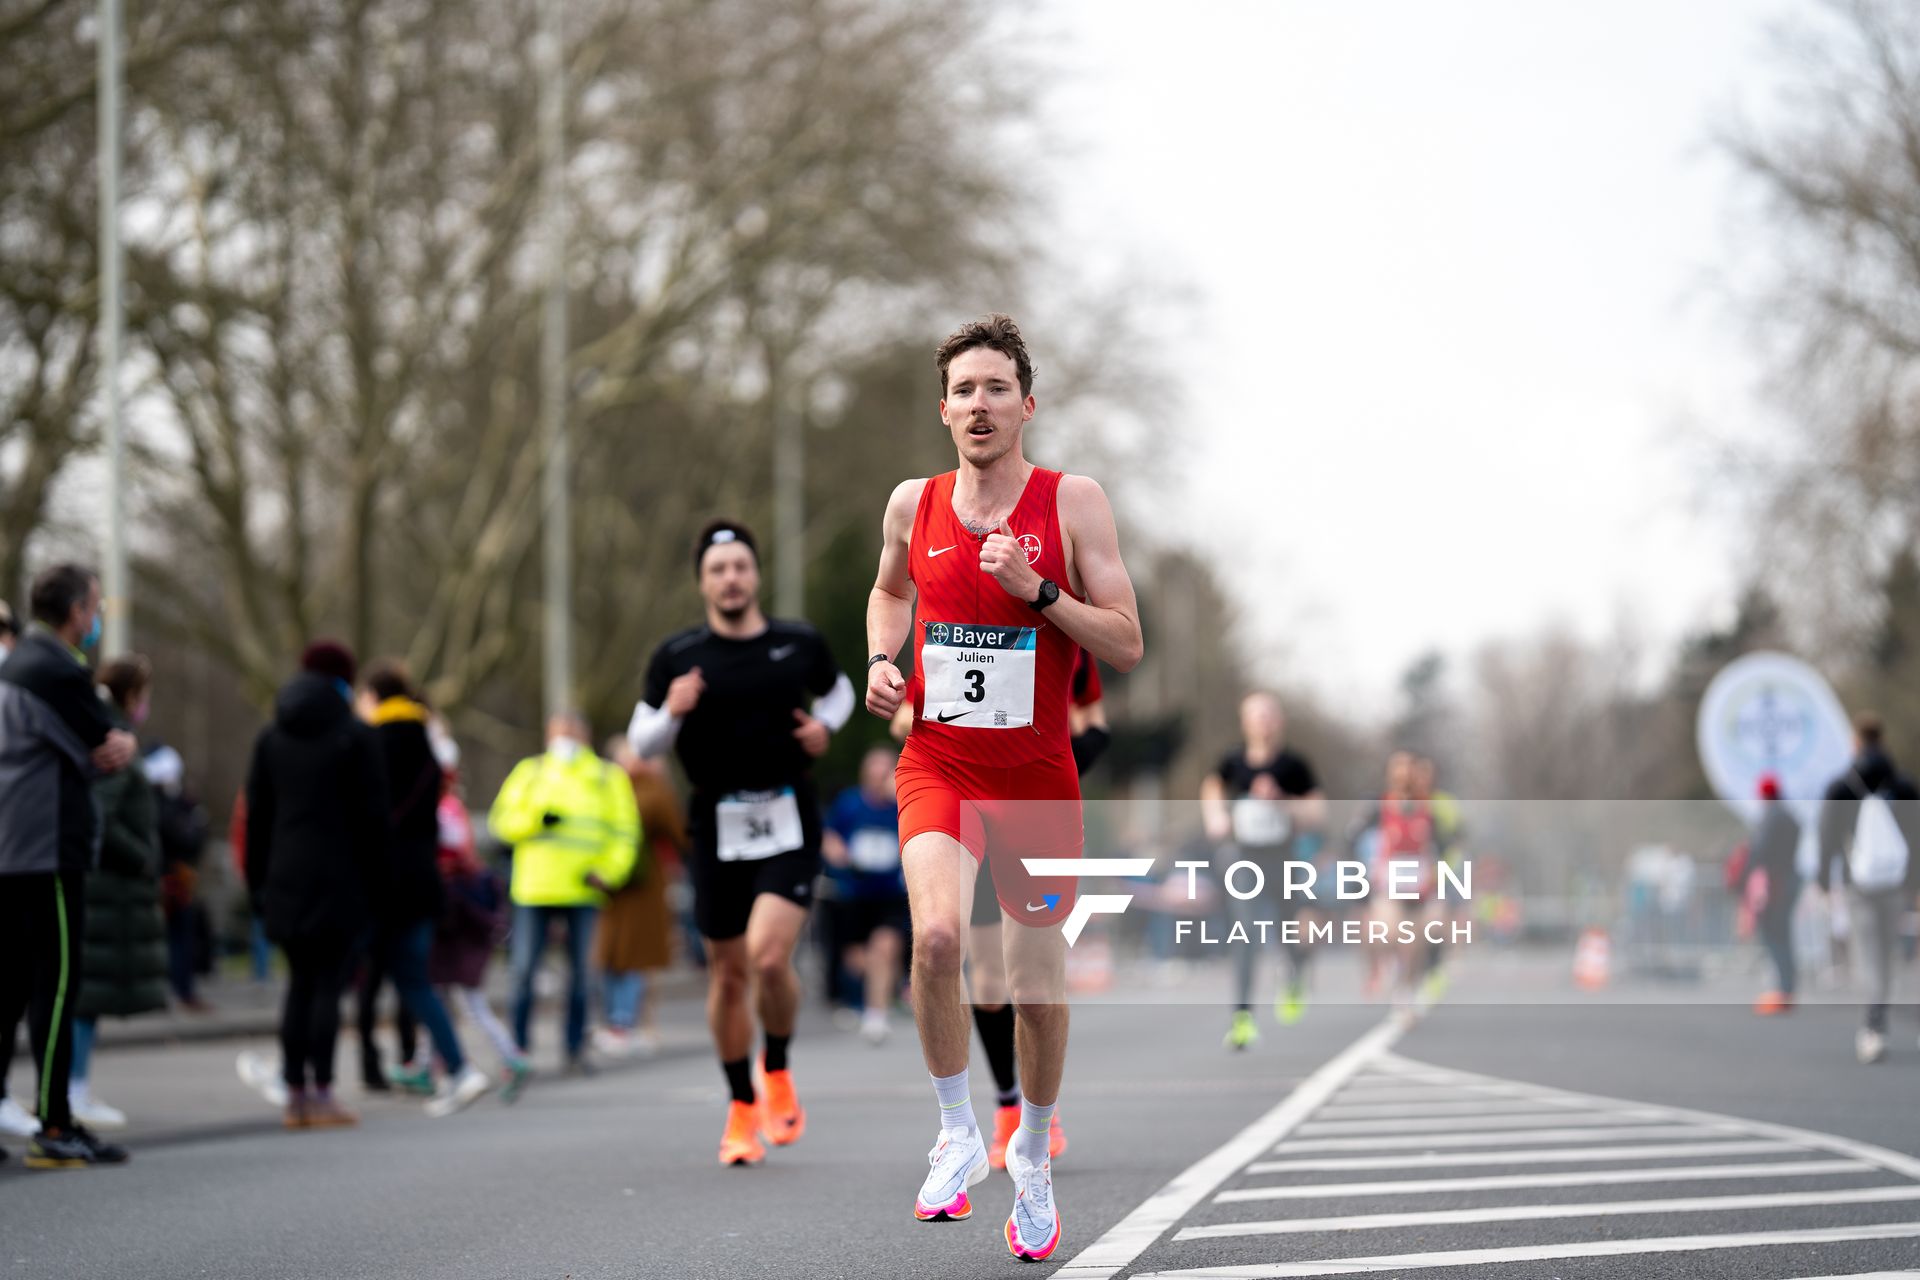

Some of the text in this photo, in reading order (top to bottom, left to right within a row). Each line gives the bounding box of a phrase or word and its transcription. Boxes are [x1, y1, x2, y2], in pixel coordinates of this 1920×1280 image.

[952, 626, 1006, 648] Bayer
[956, 651, 995, 664] Julien
[964, 669, 986, 703] 3
